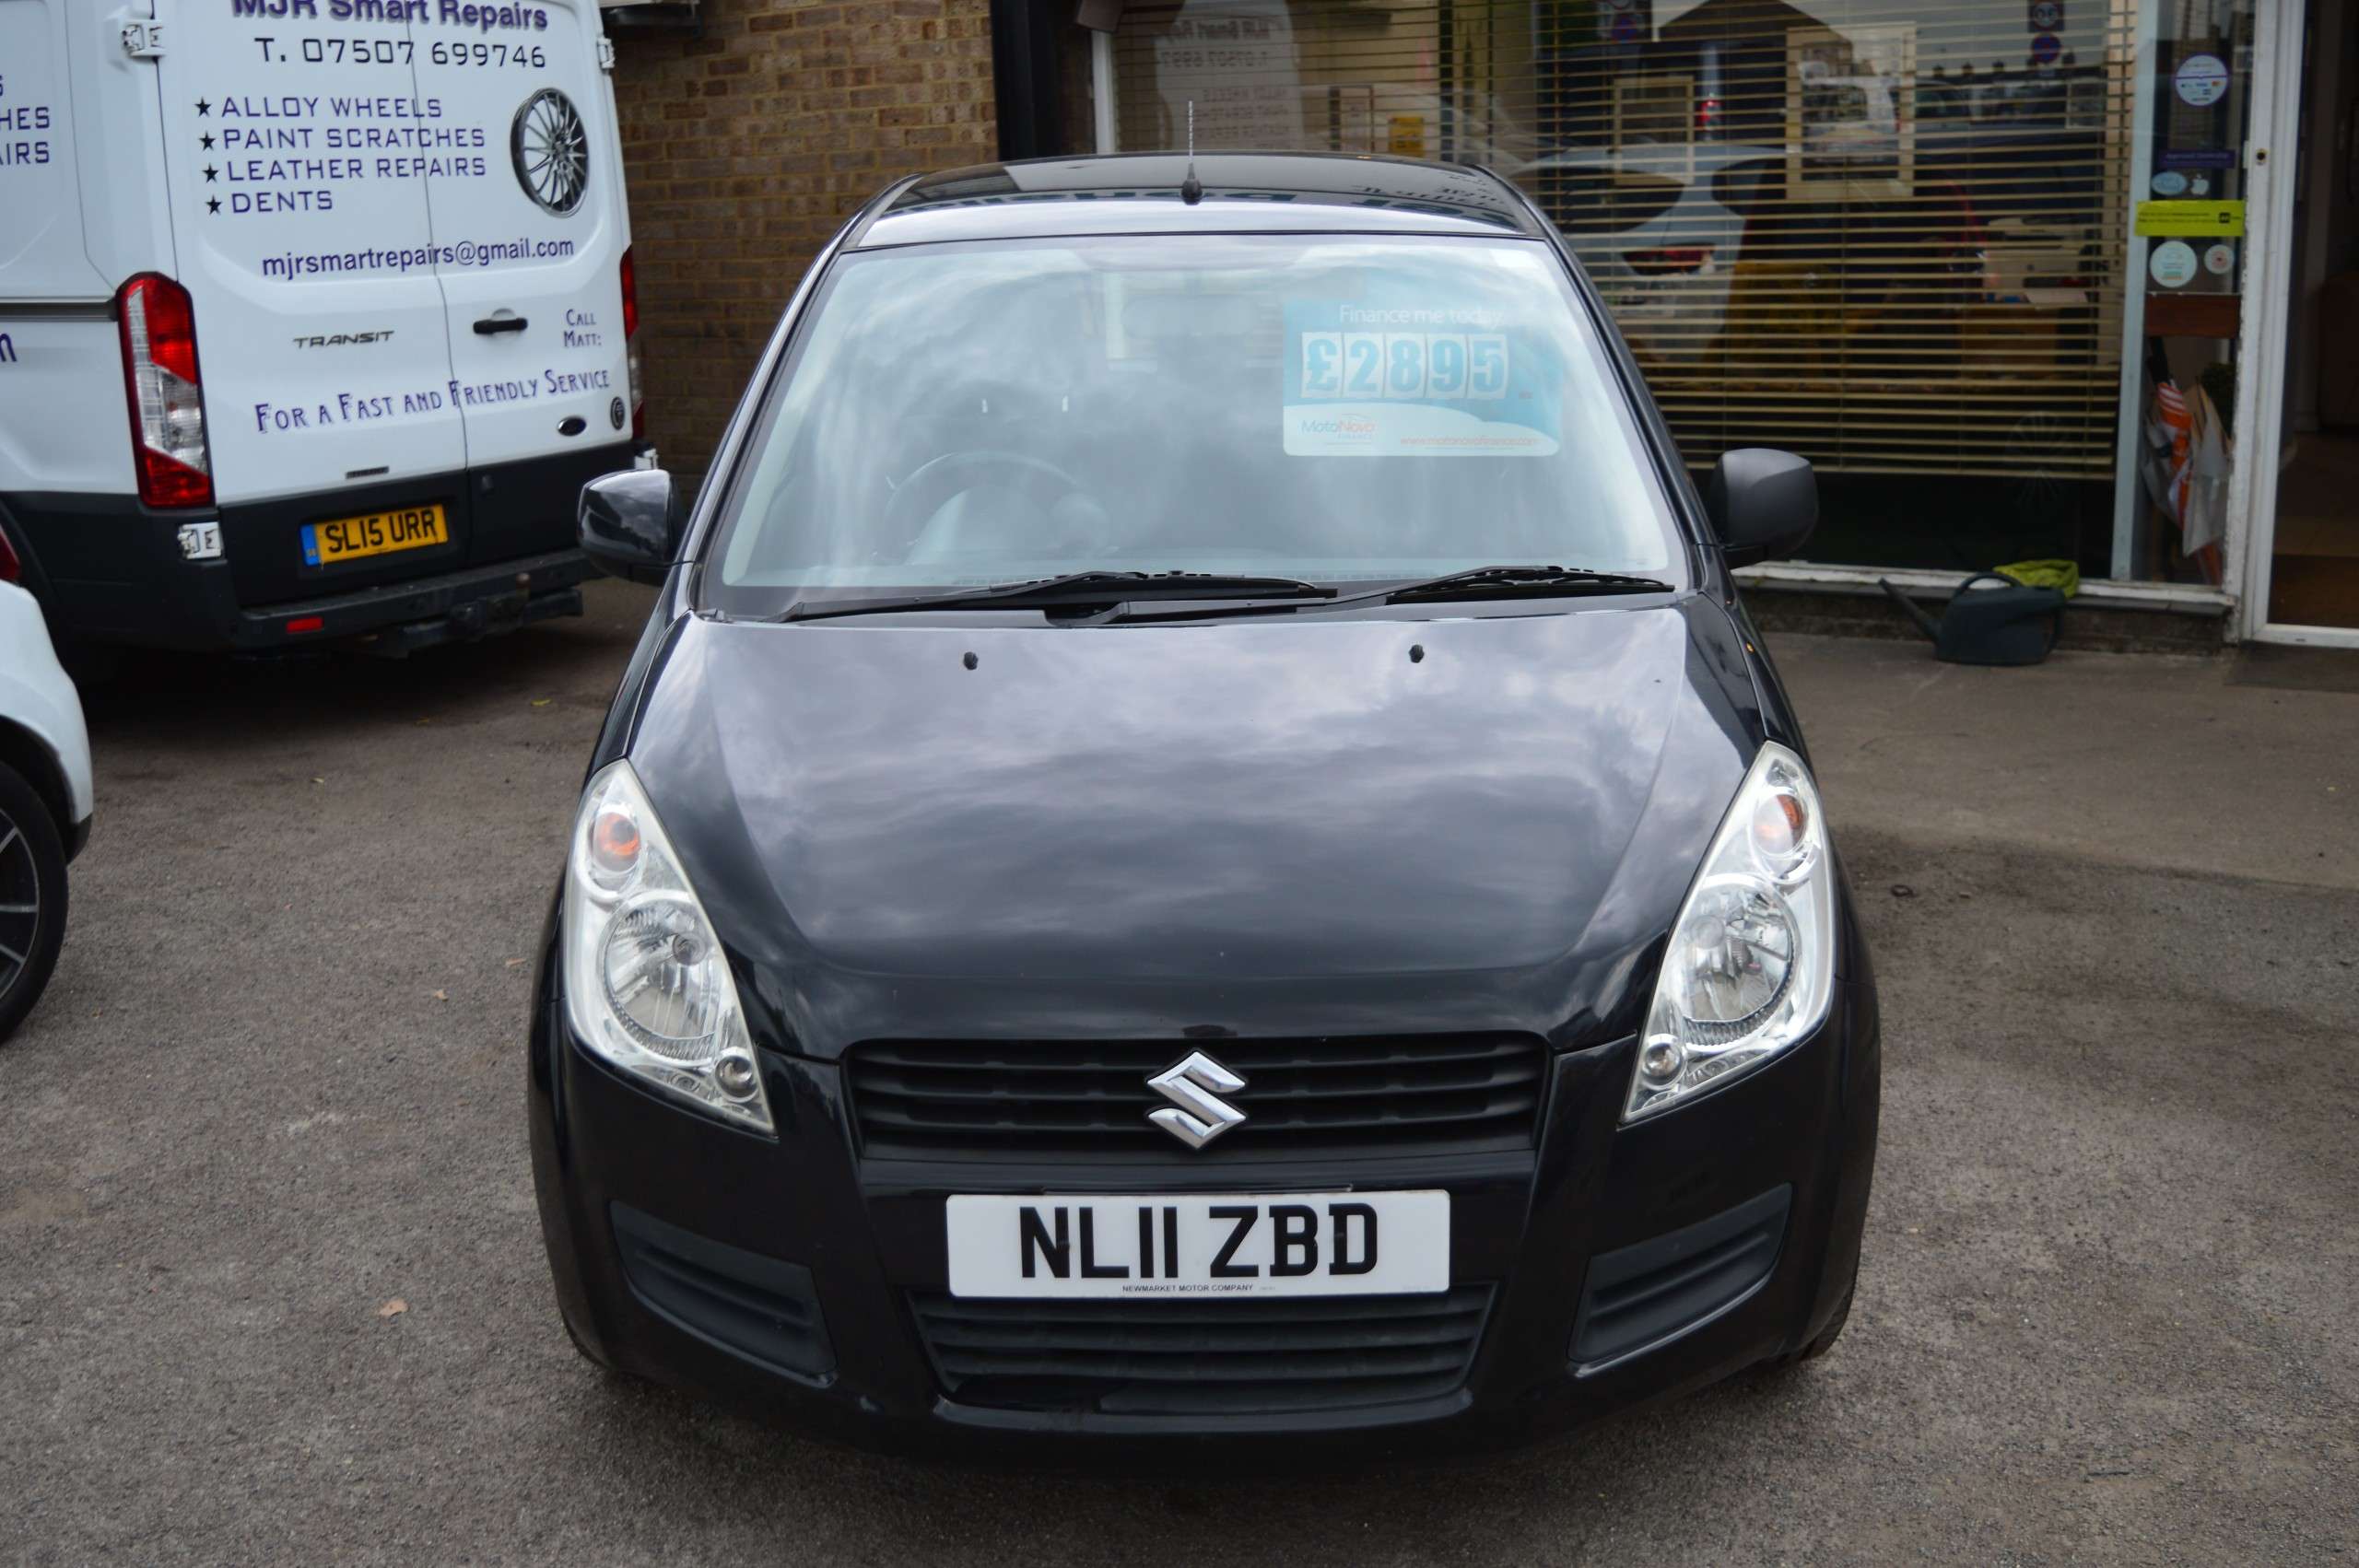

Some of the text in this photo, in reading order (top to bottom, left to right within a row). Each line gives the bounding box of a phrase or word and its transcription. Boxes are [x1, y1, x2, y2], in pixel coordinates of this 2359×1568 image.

[231, 0, 548, 32] MJR Smart Repairs
[254, 37, 546, 68] T. 07507 699746
[221, 97, 442, 118] ALLOY WHEELS
[223, 128, 486, 149] PAINT SCRATCHES
[227, 158, 487, 181] LEATHER REPAIRS
[231, 191, 333, 214] DENTS
[262, 238, 575, 280] mjrsmartrepairs@gmail.com
[1340, 305, 1410, 323] Finance
[1414, 309, 1446, 323] me
[293, 330, 395, 349] TRANSIT
[1307, 338, 1506, 392] £2895
[325, 509, 439, 553] SL15 URR
[1019, 1202, 1379, 1279] NL11 ZBD
[1121, 1284, 1177, 1293] NEWMARKET
[1179, 1283, 1209, 1292] MOTOR
[1211, 1282, 1254, 1292] COMPANY
